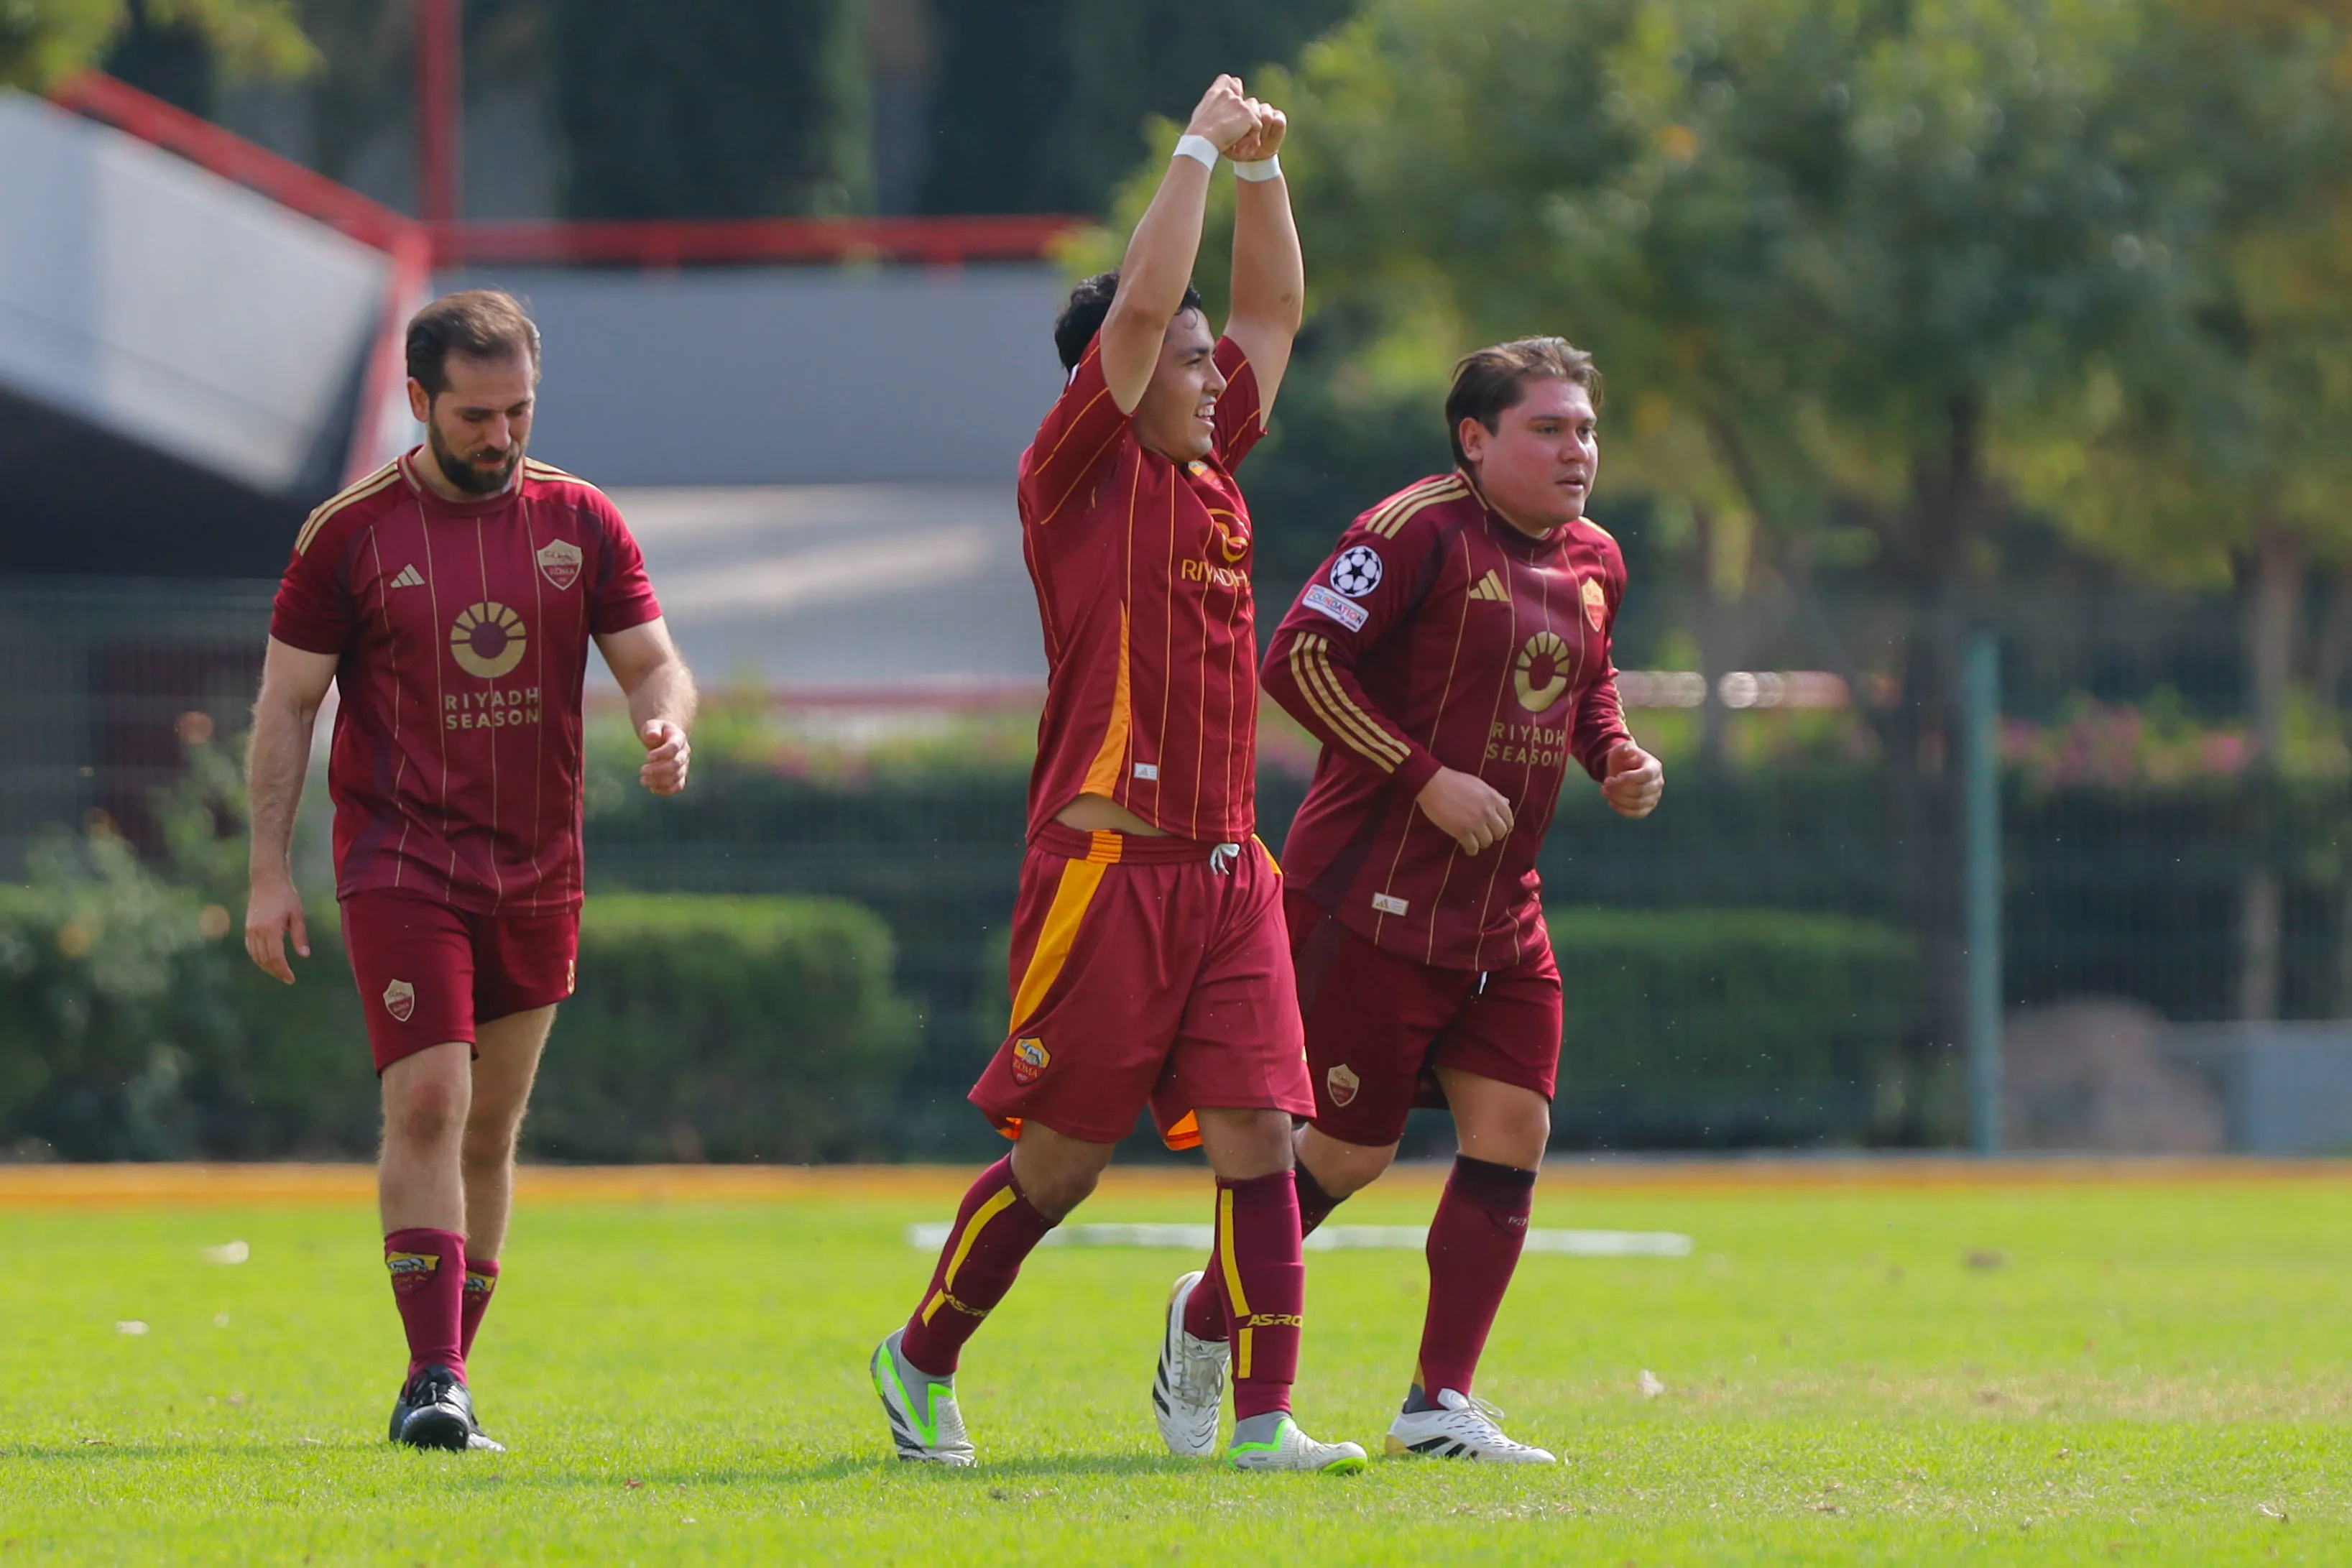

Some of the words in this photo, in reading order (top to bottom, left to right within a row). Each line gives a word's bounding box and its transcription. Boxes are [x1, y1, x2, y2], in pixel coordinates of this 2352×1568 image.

[1181, 559, 1248, 588] RIYADH
[1308, 590, 1364, 624] FOUNDATION
[445, 687, 538, 710] RIYADH
[446, 709, 539, 729] SEASON
[1491, 721, 1565, 747] RIYADH
[1486, 743, 1562, 767] SEASON
